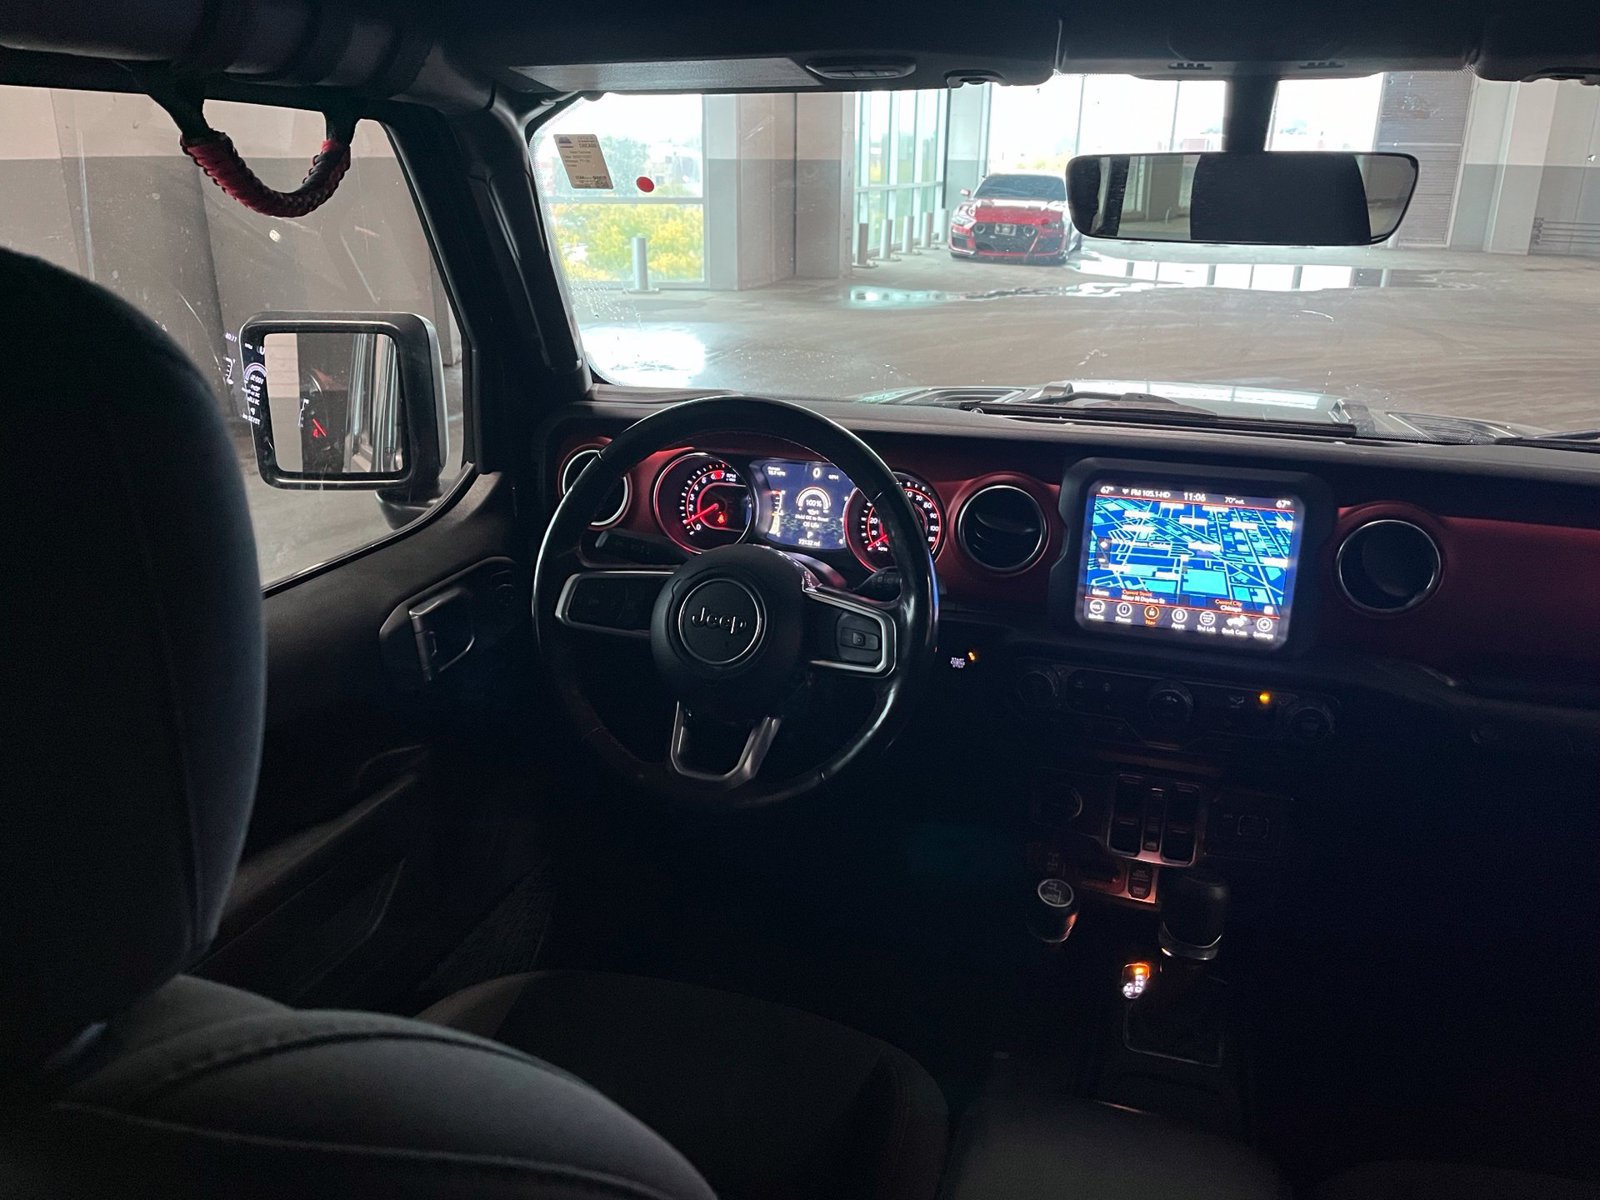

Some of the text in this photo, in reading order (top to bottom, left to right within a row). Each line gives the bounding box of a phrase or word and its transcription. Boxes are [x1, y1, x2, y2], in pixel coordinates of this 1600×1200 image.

[812, 467, 821, 479] 0
[1100, 486, 1114, 495] 67°
[1183, 492, 1206, 502] 11:06
[1276, 499, 1291, 509] 67°
[696, 523, 702, 531] 0
[691, 606, 747, 634] Jeep
